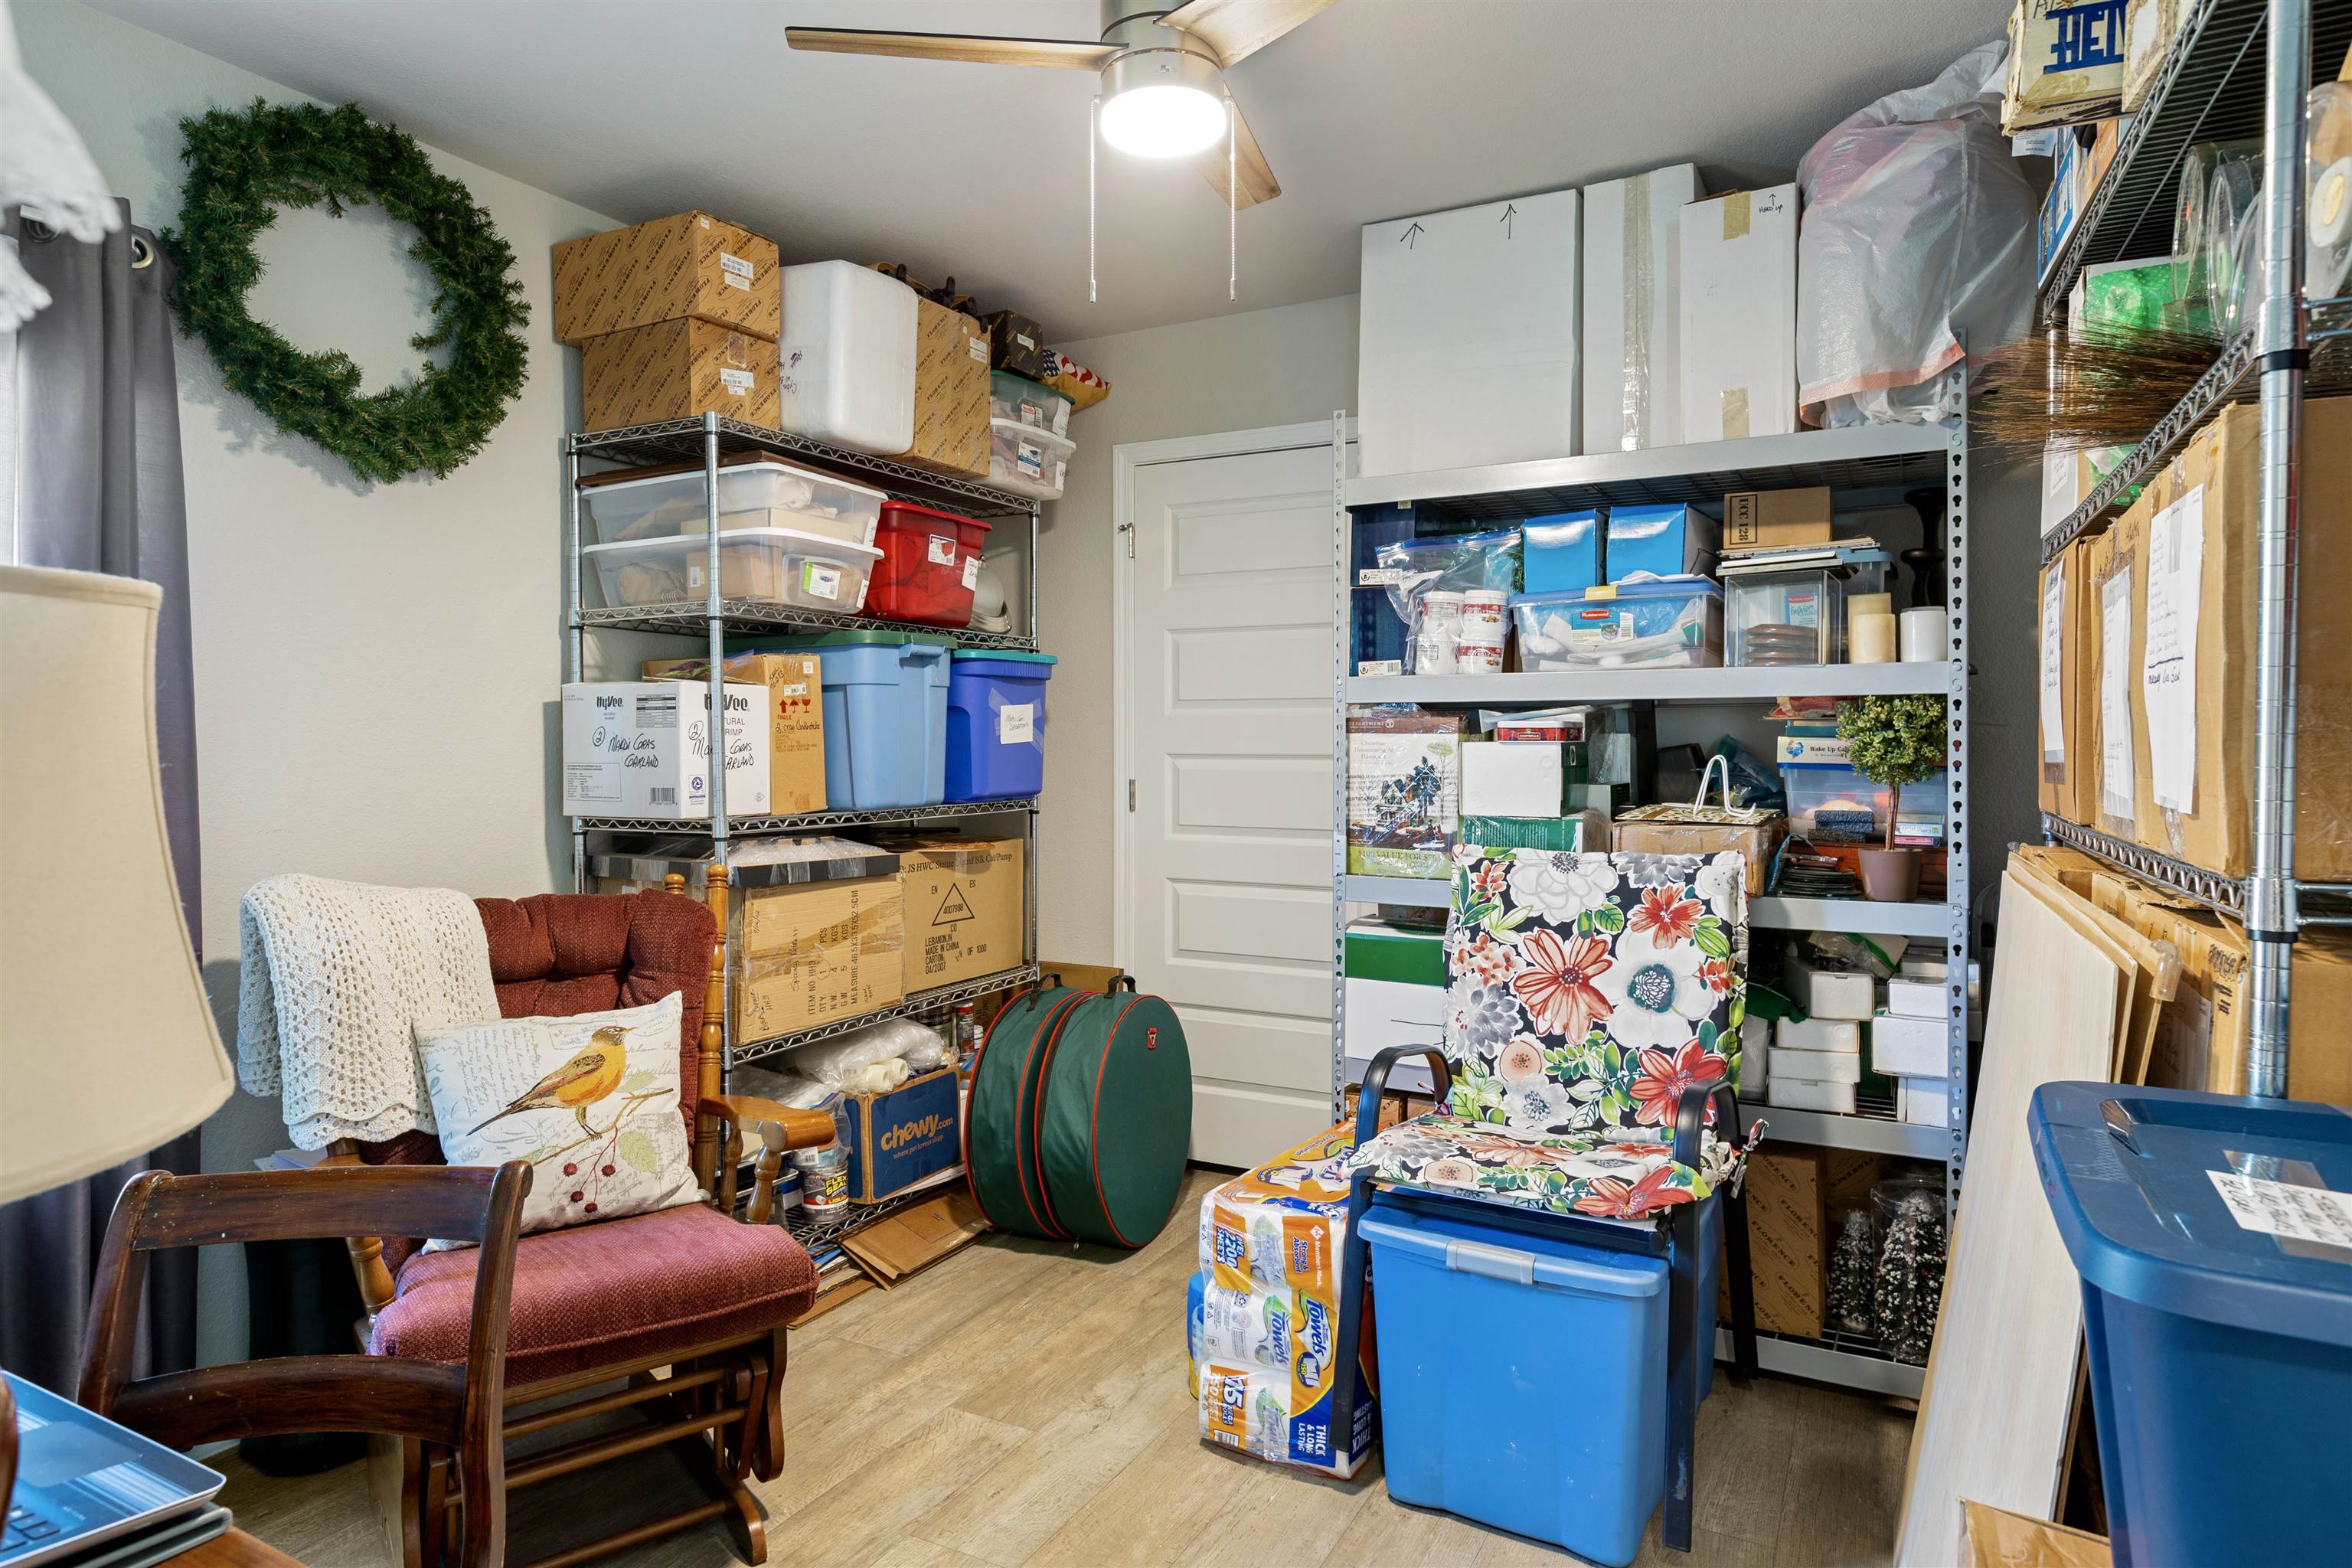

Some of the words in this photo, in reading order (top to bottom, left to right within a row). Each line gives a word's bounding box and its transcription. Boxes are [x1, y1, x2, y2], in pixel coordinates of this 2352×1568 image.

[645, 228, 671, 272] FLORENCE
[698, 237, 727, 266] FLORENCE
[614, 259, 639, 301] FLORENCE
[664, 250, 691, 293] FLORENCE
[751, 260, 778, 288] FLORENCE
[632, 280, 656, 322] FLORENCE
[682, 276, 710, 315] FLORENCE
[927, 313, 948, 338] FLORENCE
[927, 375, 949, 401] FLORENCE
[750, 388, 777, 417] FLORENCE
[1740, 498, 1749, 520] UCC
[1739, 523, 1749, 541] 128
[596, 695, 622, 710] HyVee
[704, 694, 748, 710] HVee
[691, 724, 698, 738] 2
[624, 754, 658, 769] GARLAND
[725, 753, 754, 770] ARLAND
[907, 864, 915, 873] JS
[916, 861, 934, 871] HWC
[975, 855, 985, 864] Blk
[932, 886, 938, 894] EN
[970, 880, 976, 888] ES
[926, 946, 939, 956] MADE
[946, 942, 959, 951] CHINA
[968, 947, 974, 956] OF
[977, 944, 987, 953] 1000
[925, 962, 946, 974] 04/2007
[809, 981, 815, 991] NO
[880, 1114, 953, 1151] chewy.com
[894, 1148, 909, 1159] where
[918, 1140, 932, 1152] lovers
[933, 1135, 944, 1145] shop
[826, 1175, 847, 1188] FLEX
[1762, 1156, 1795, 1191] ORENCE
[826, 1181, 847, 1196] SEAL
[1780, 1199, 1818, 1238] FLORENC
[1216, 1226, 1225, 1264] SHEETS
[1225, 1230, 1238, 1269] 2200
[1236, 1233, 1246, 1258] OVER
[1293, 1236, 1302, 1274] Absorbent
[1301, 1240, 1309, 1265] Strong
[1752, 1220, 1796, 1267] FLORENCE
[1270, 1311, 1289, 1366] Towels
[1306, 1298, 1326, 1357] Towels
[1354, 1400, 1372, 1422] LASTING
[1354, 1416, 1367, 1436] LONG
[1315, 1424, 1326, 1456] THICK
[1352, 1426, 1371, 1455] THICK
